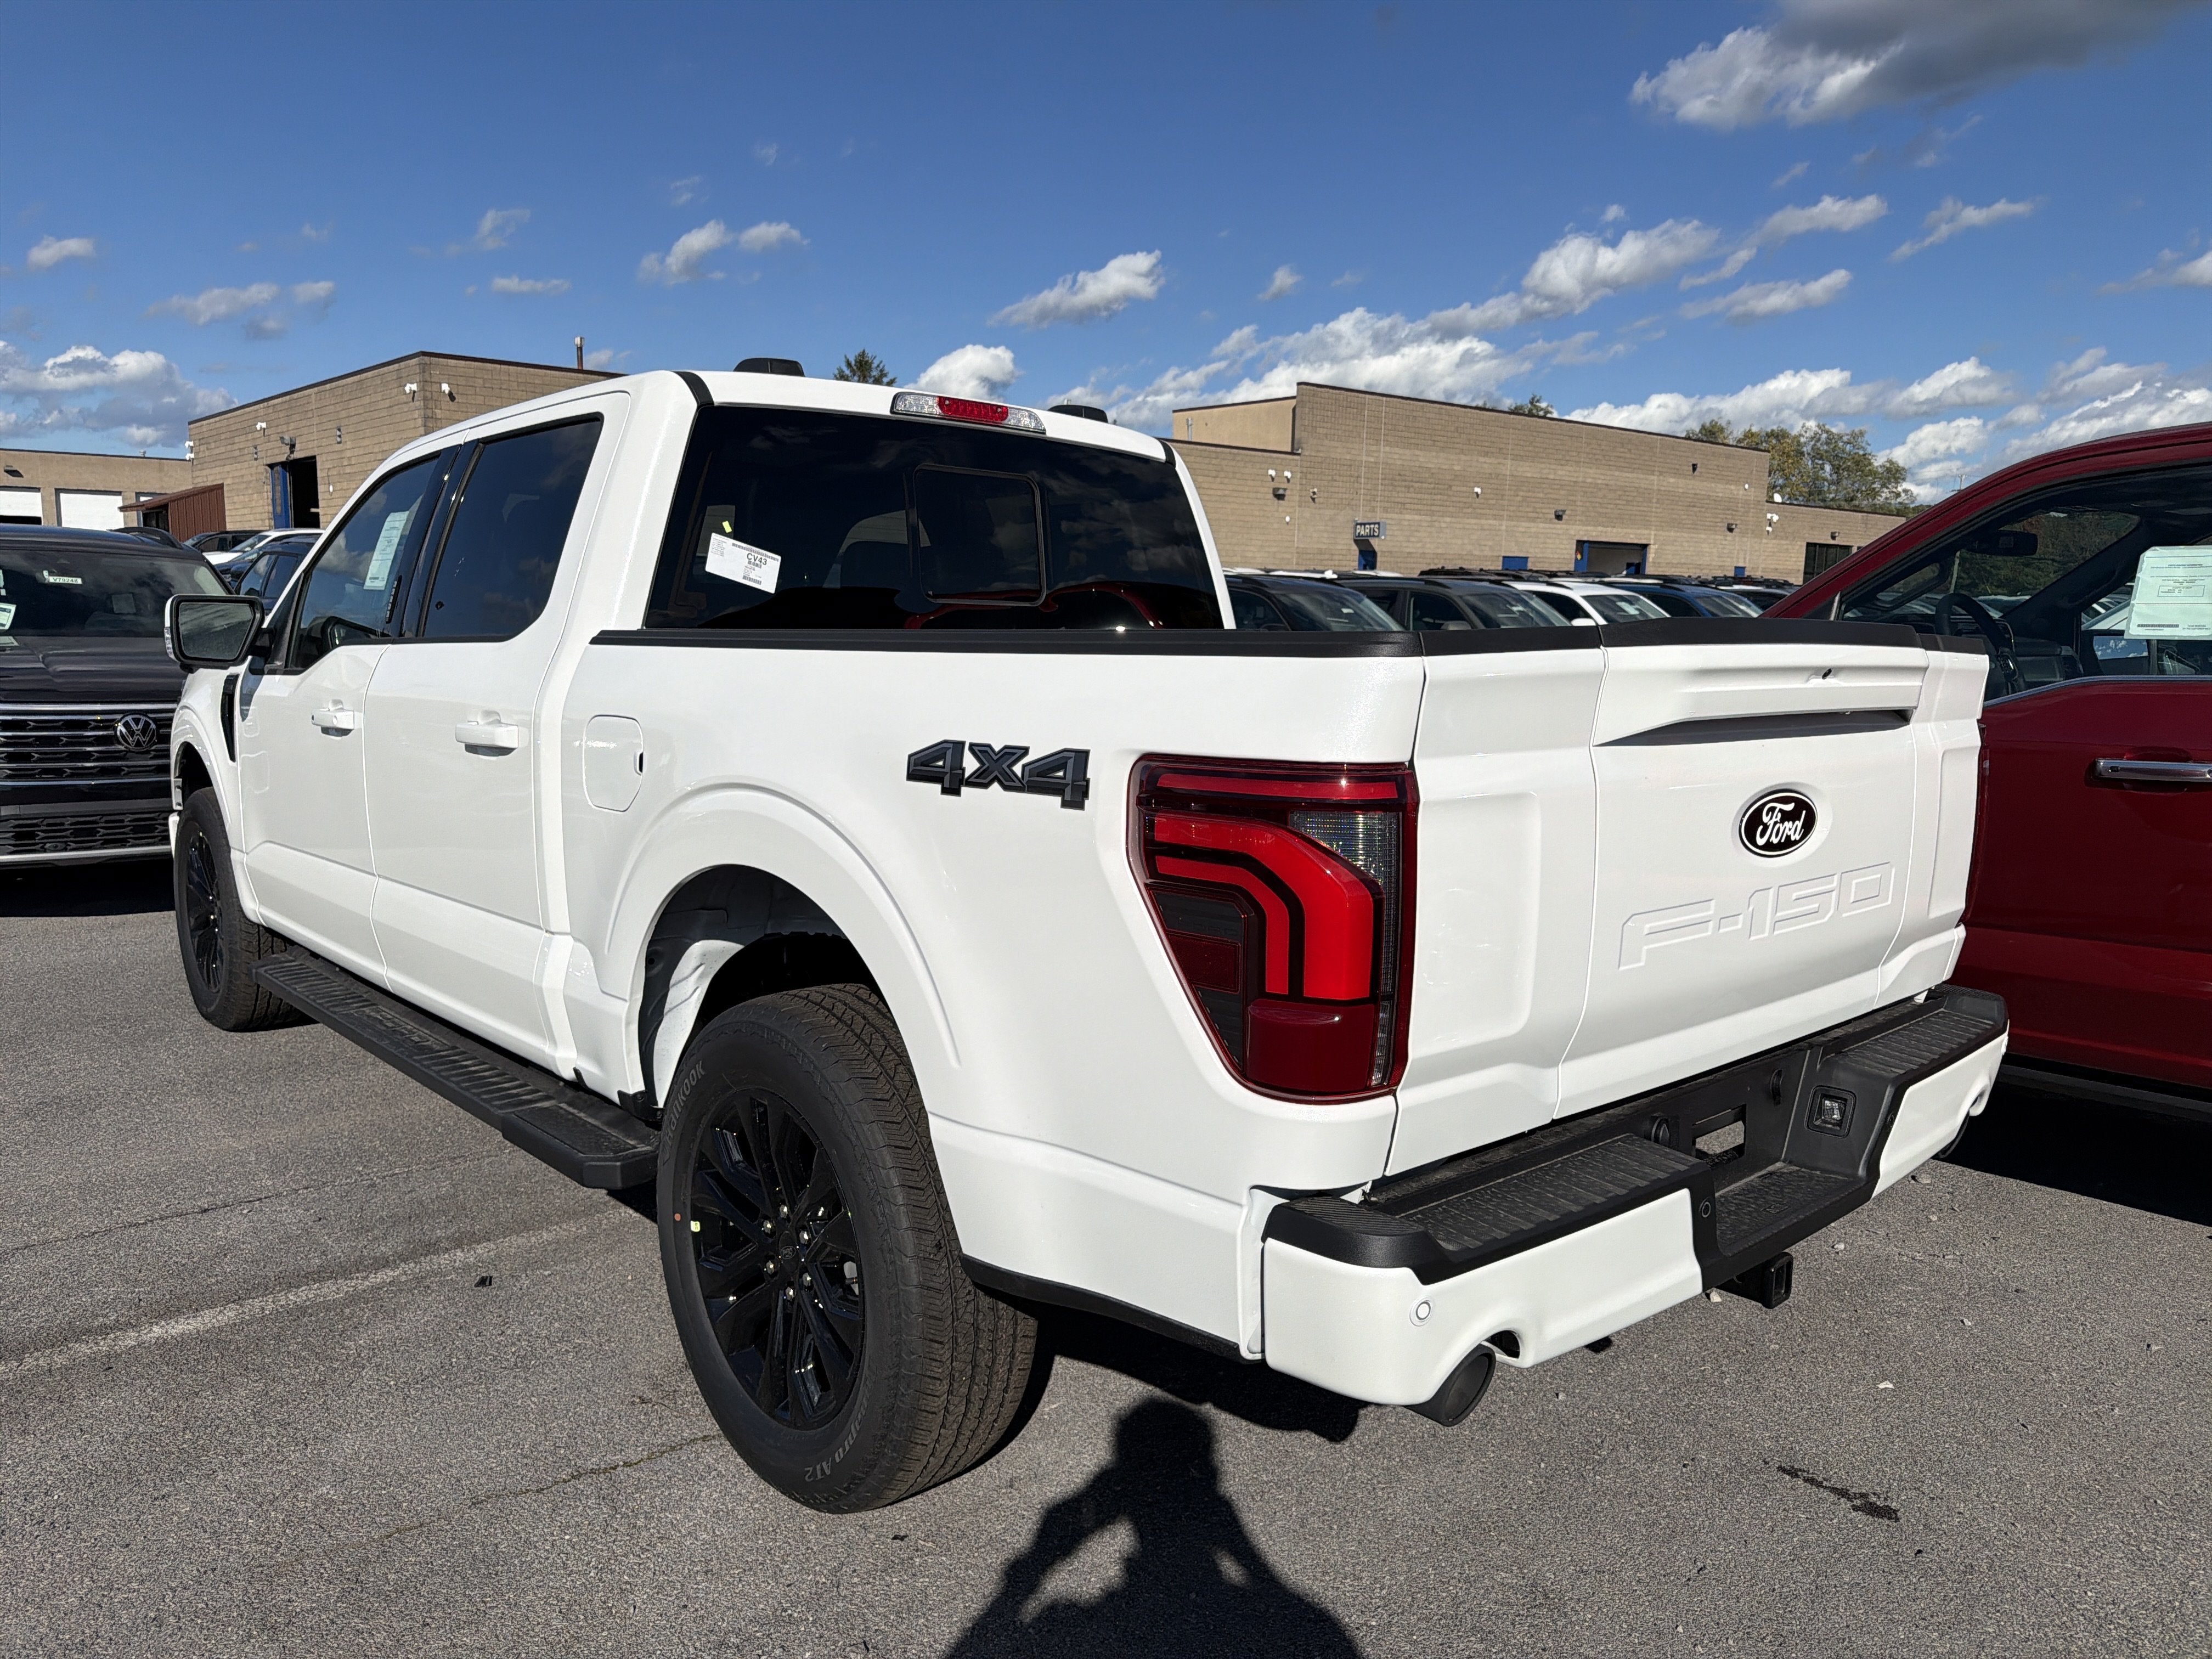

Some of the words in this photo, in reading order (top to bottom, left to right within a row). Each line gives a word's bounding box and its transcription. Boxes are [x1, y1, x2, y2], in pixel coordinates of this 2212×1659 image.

[1356, 524, 1379, 536] PARTS
[747, 552, 767, 566] CV43
[1756, 802, 1806, 846] Ford
[1618, 861, 1895, 970] F-150
[804, 1457, 832, 1482] AT2
